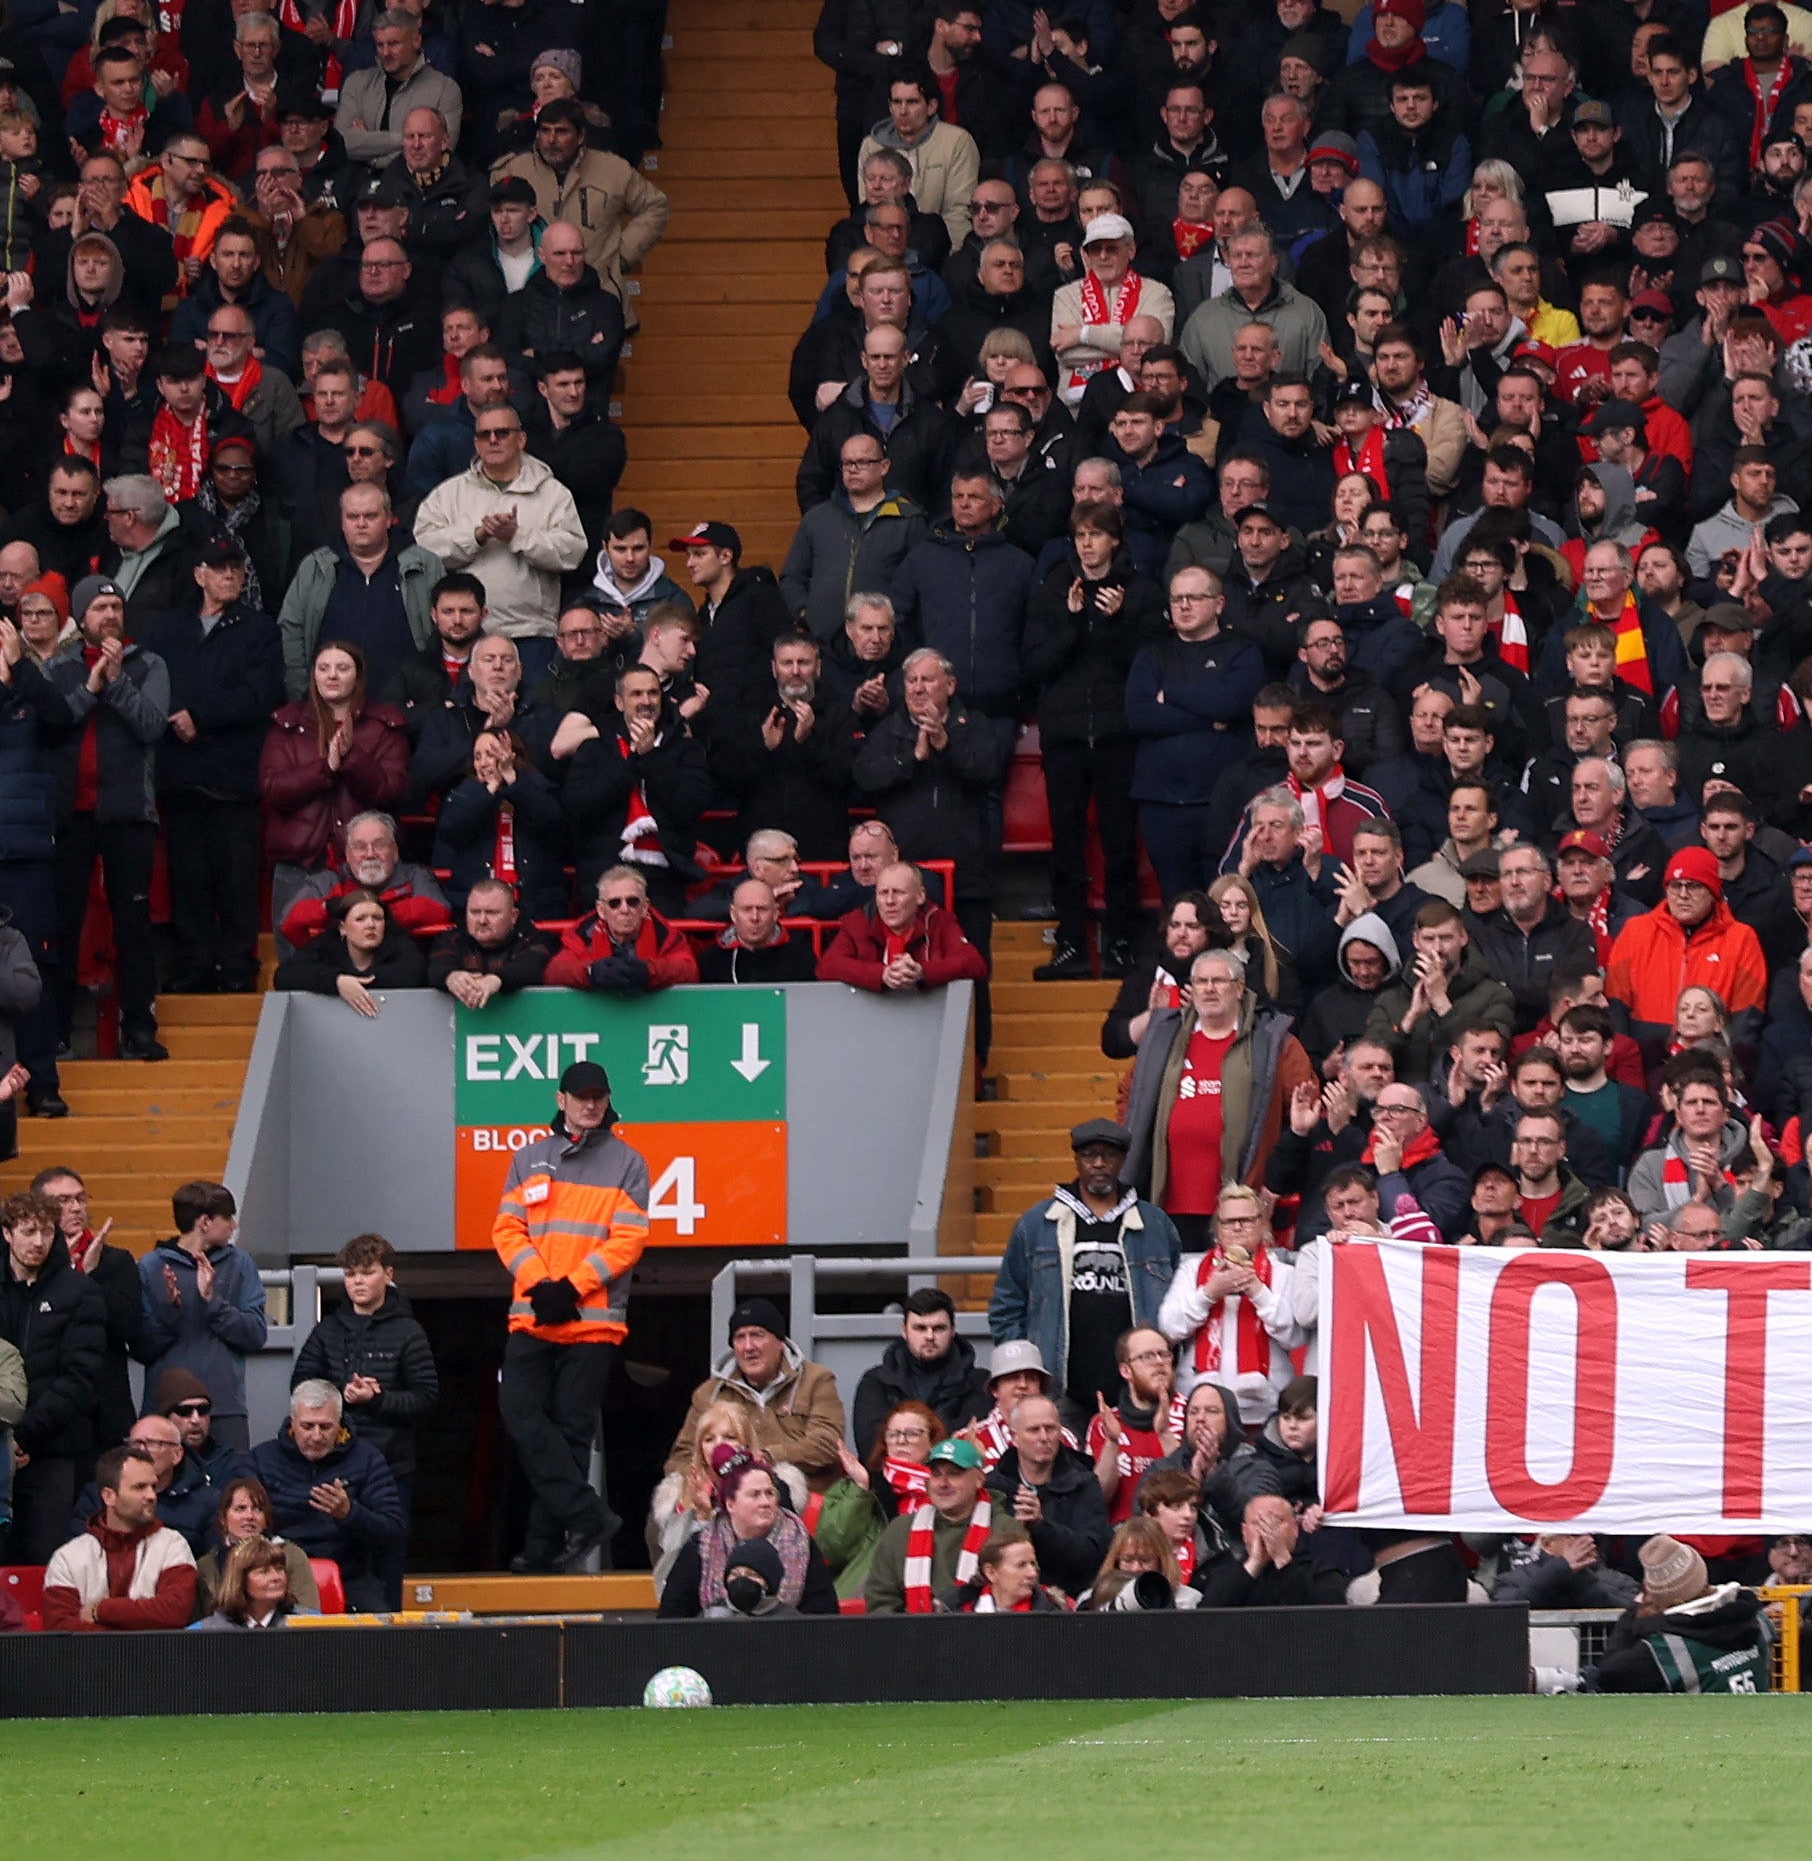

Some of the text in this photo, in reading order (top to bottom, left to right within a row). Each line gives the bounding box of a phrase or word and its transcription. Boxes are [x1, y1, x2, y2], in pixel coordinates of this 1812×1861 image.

[466, 1033, 600, 1080] EXIT
[473, 1129, 554, 1152] BLOC
[1325, 1242, 1619, 1522] NO
